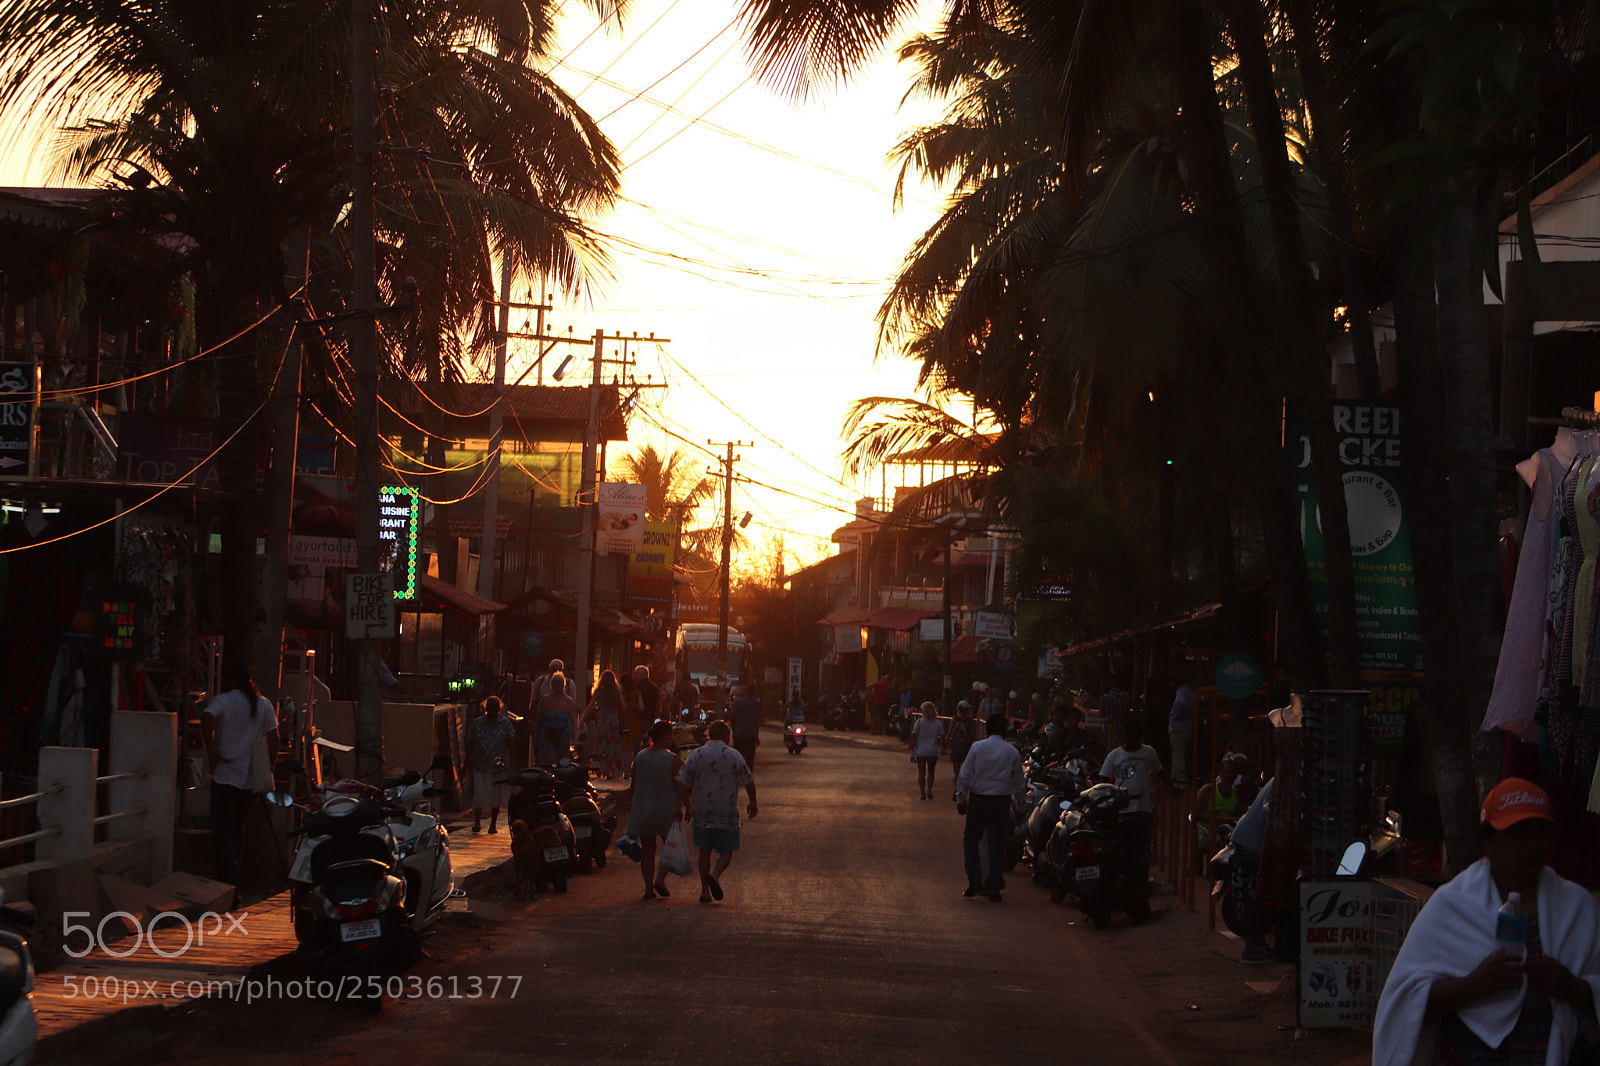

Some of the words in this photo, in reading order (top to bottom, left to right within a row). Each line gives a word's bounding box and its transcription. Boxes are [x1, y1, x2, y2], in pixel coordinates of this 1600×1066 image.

[0, 403, 27, 426] RS
[380, 506, 410, 517] UISINE
[379, 518, 406, 528] RANT
[353, 576, 388, 592] BIKE
[358, 592, 386, 607] FOR
[351, 605, 388, 620] HIRE
[1306, 927, 1339, 943] BIKE
